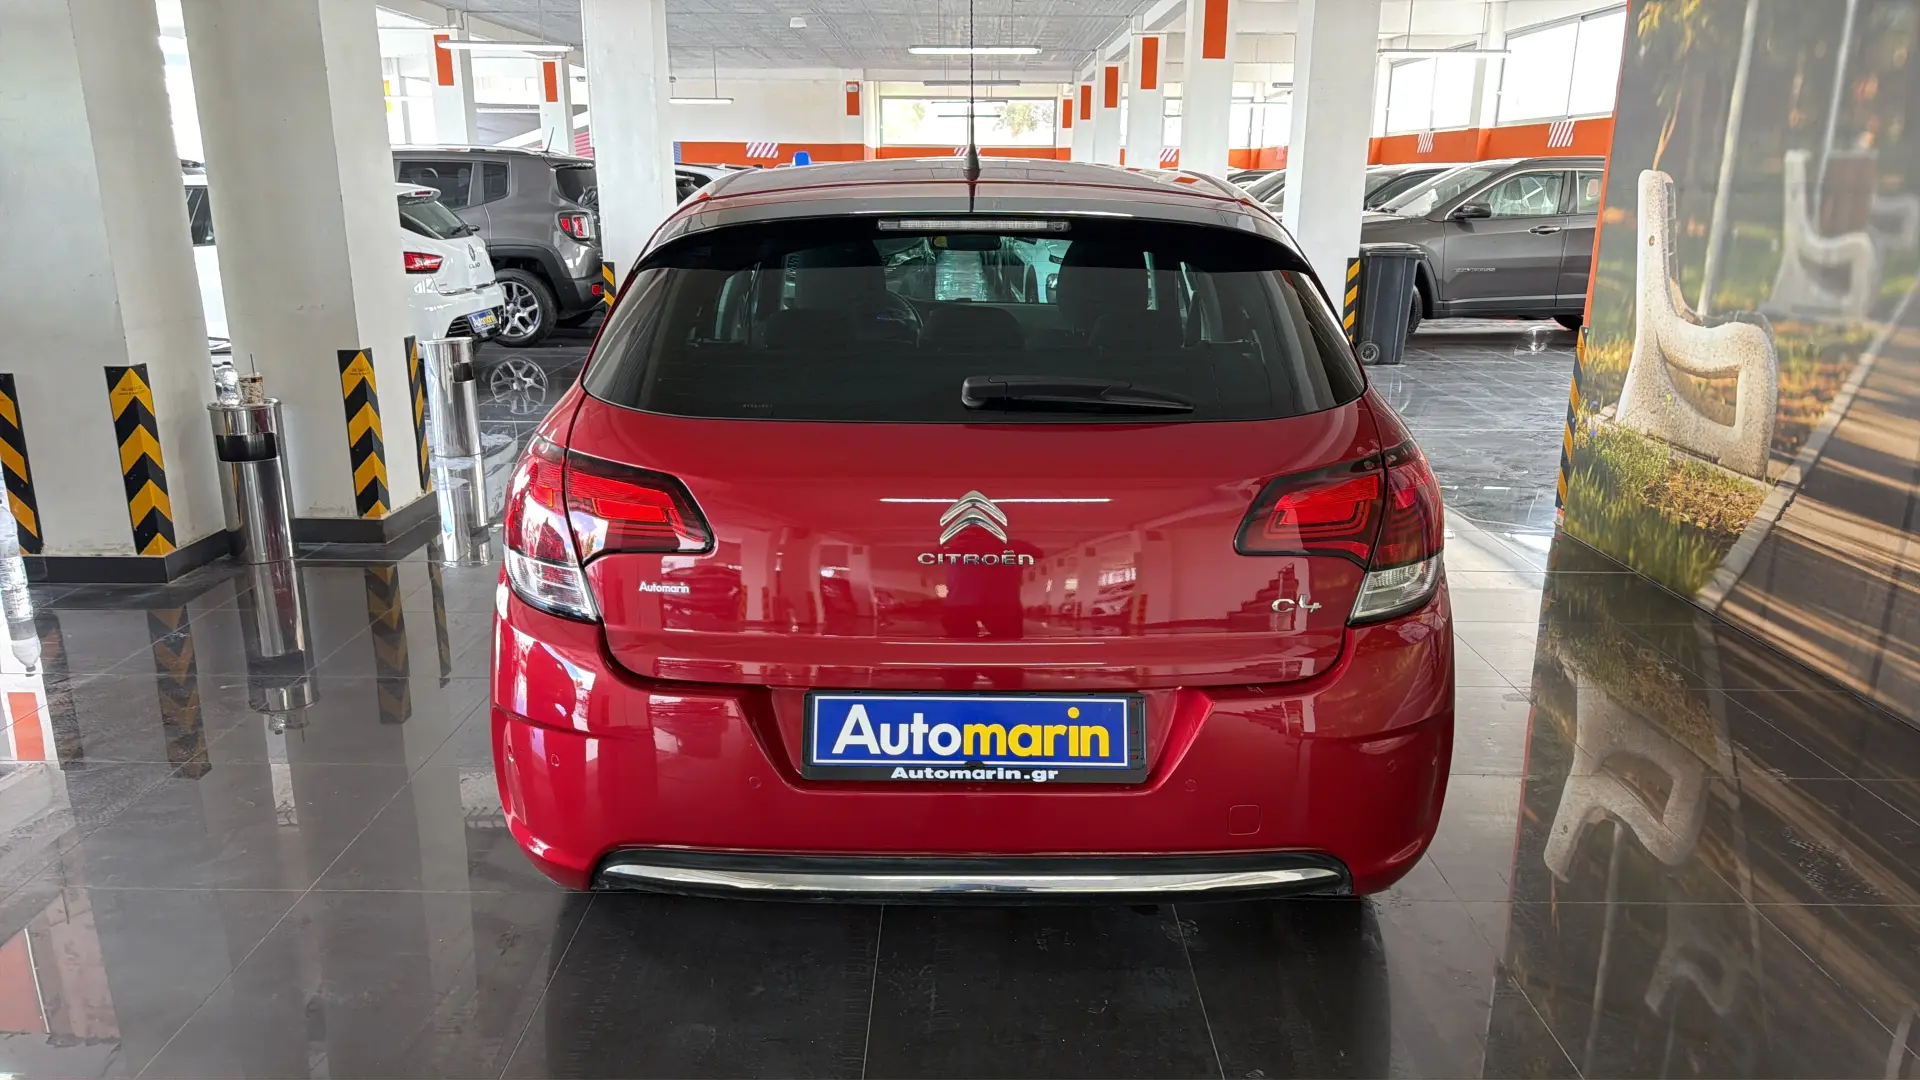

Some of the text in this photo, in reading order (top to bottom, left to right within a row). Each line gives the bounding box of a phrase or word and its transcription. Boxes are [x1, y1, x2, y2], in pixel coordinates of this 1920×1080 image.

[639, 581, 690, 593] Automarin
[1271, 594, 1322, 613] C4
[831, 704, 1110, 757] Automarin
[891, 767, 1058, 782] Automarin.gr
